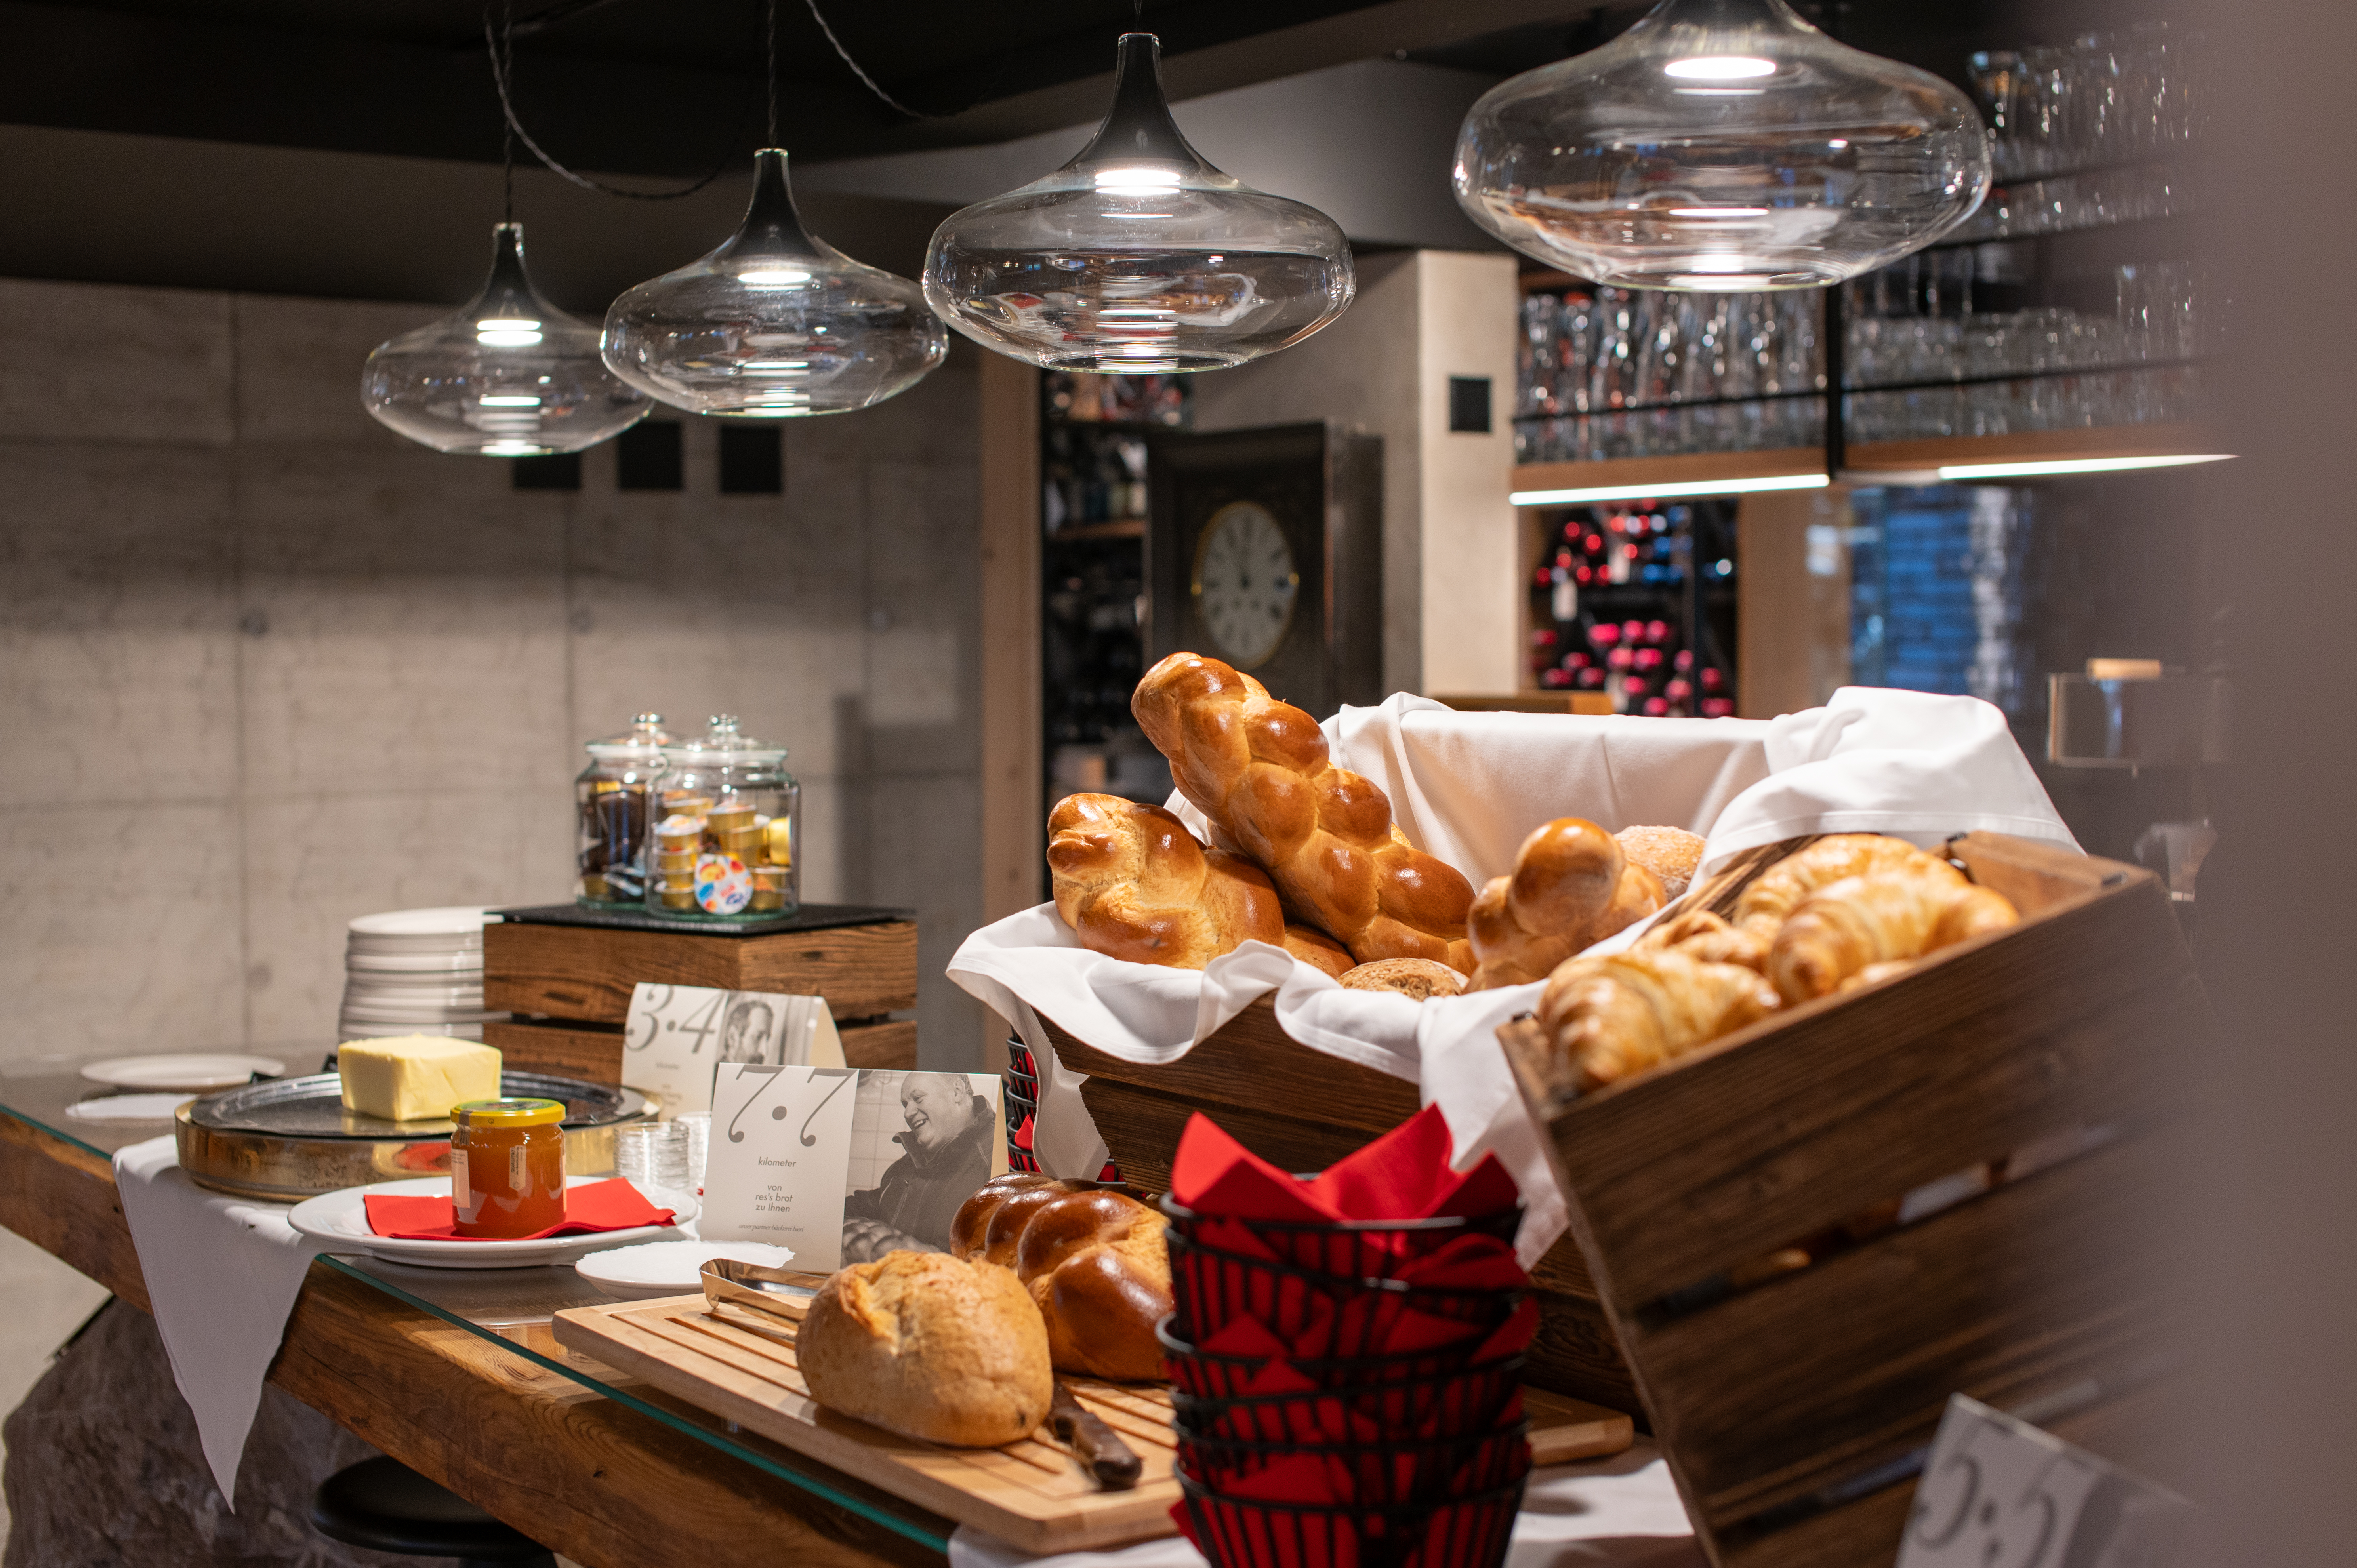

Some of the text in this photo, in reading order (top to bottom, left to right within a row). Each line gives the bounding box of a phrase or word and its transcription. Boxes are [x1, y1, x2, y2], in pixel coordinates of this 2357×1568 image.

[758, 1156, 796, 1167] kilometer
[775, 1193, 793, 1202] brot
[768, 1203, 790, 1212] Ihnen
